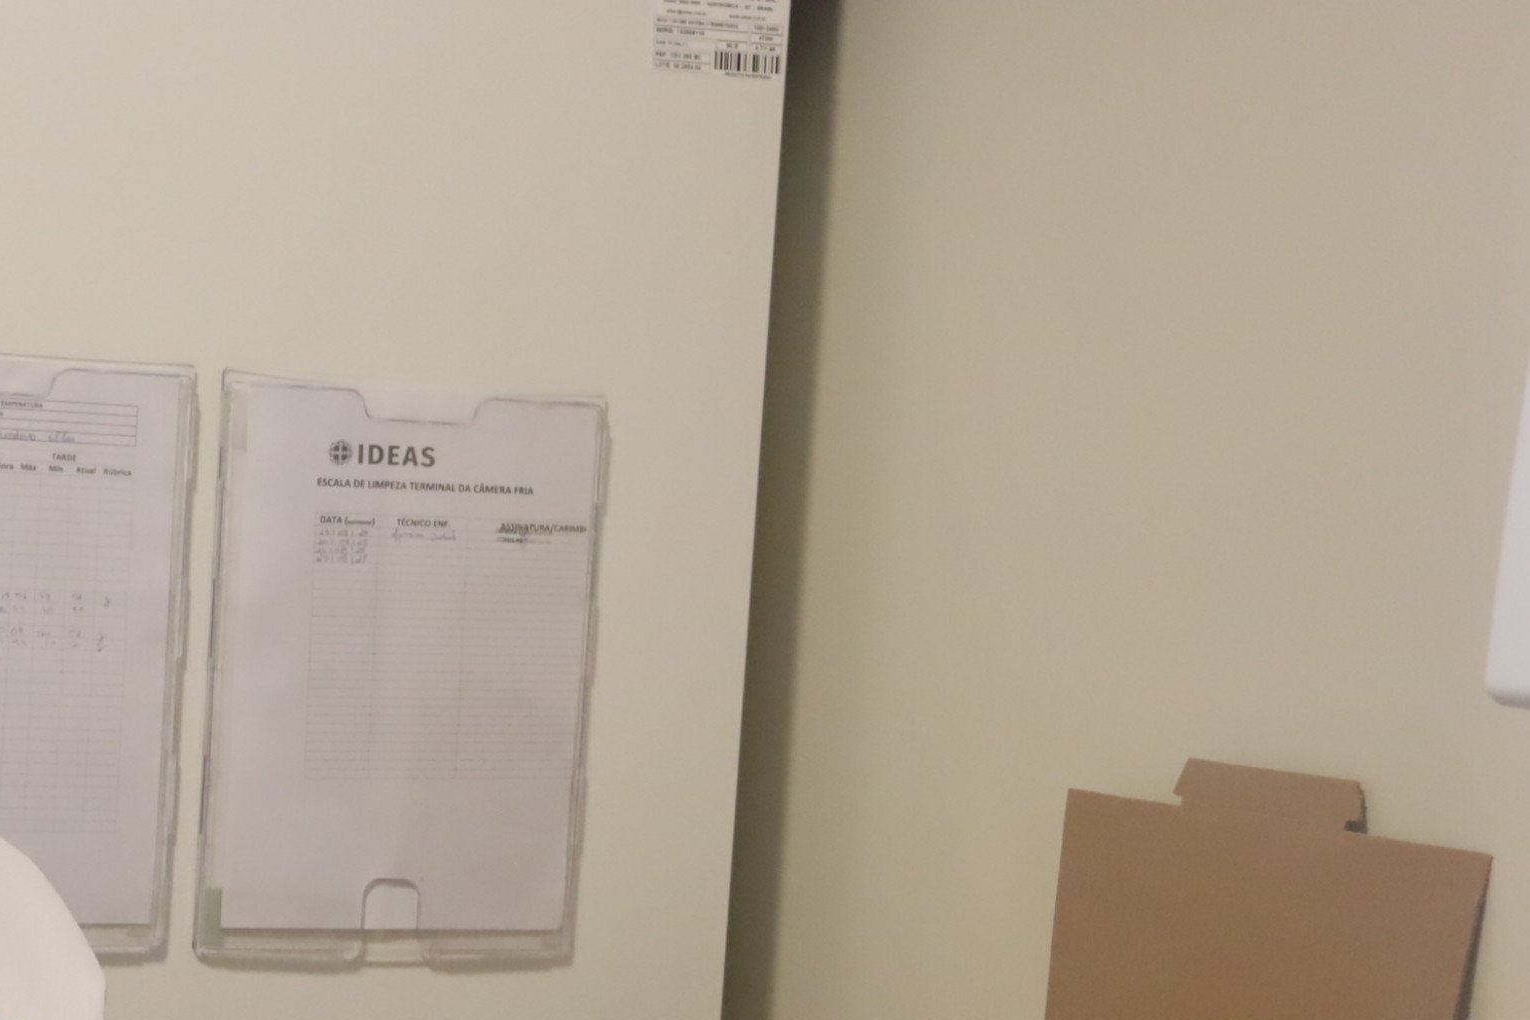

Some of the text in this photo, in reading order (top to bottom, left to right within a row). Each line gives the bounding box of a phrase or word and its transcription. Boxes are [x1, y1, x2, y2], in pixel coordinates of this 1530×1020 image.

[52, 453, 77, 463] TARDE
[358, 443, 436, 467] IDEAS
[317, 477, 535, 496] ESCALA DE LIMPEZA TERMINAL DA CÂMERA FRIA
[320, 515, 342, 524] DATA
[397, 517, 432, 527] TÉCNICO
